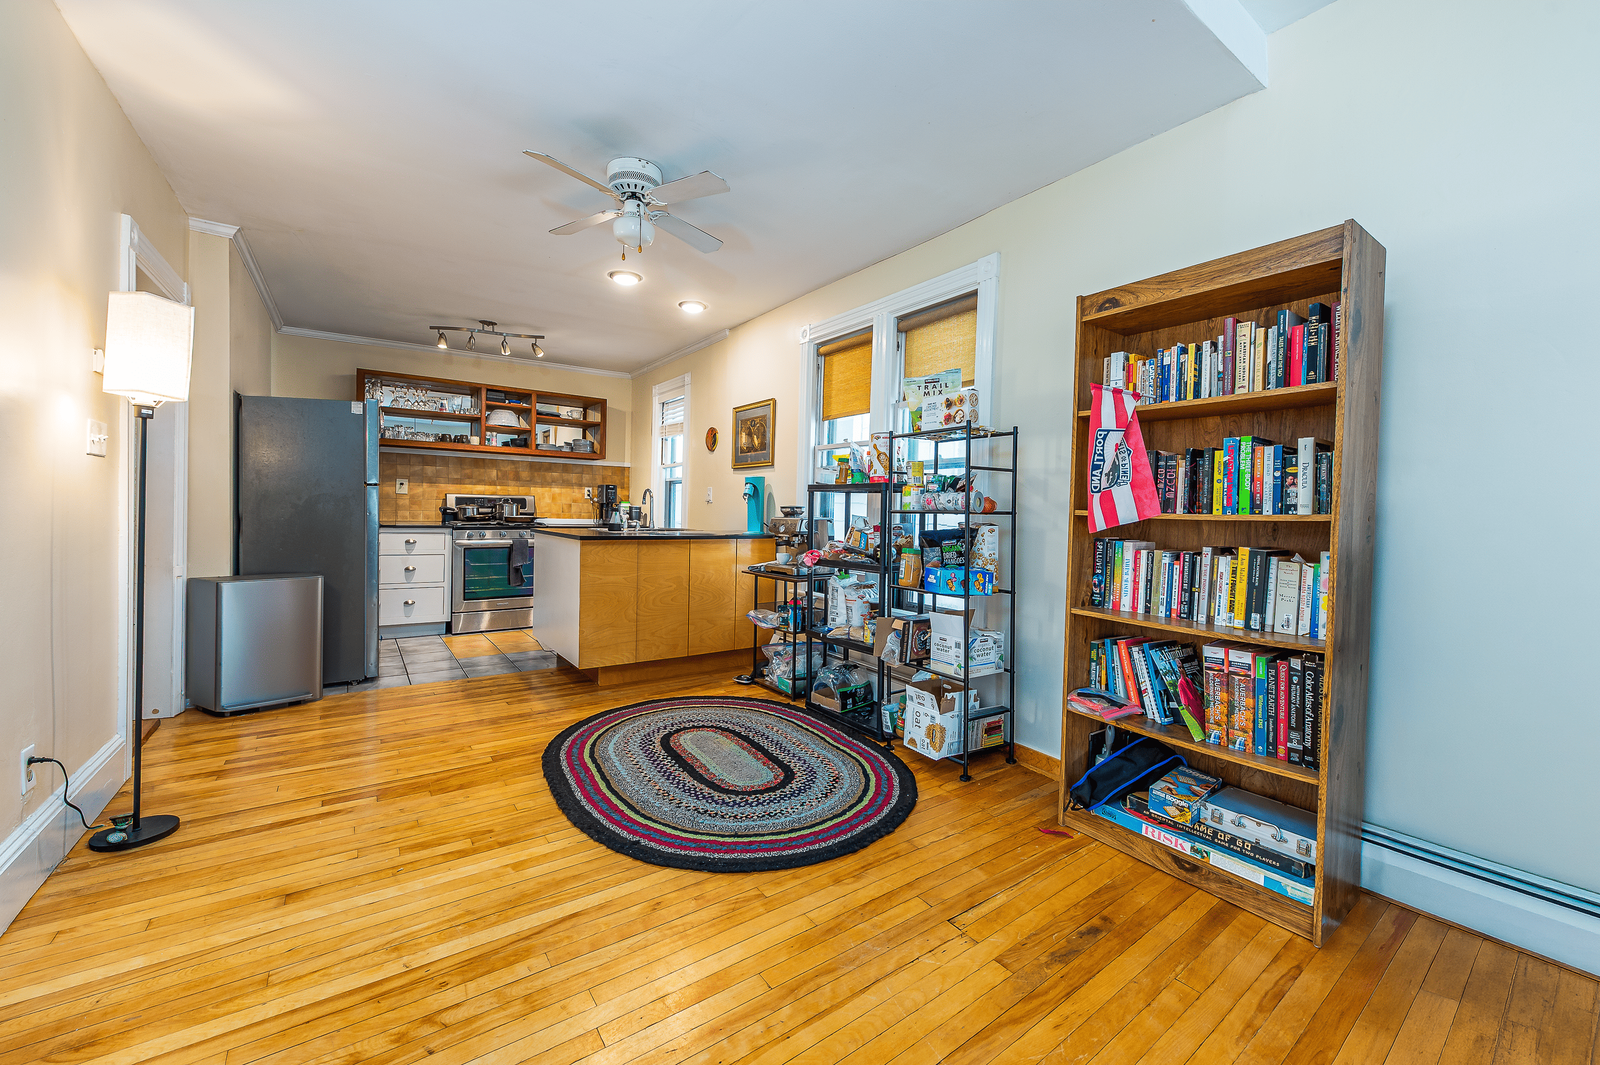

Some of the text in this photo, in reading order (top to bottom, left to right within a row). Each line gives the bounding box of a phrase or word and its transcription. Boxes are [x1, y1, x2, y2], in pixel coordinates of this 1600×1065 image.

[917, 382, 949, 391] TRAIL
[1301, 462, 1309, 489] DRACULA
[934, 642, 952, 650] coconut
[974, 646, 994, 654] coconut
[1279, 664, 1287, 681] QUEST
[1305, 671, 1314, 691] Color
[1305, 692, 1313, 707] Atlas
[1305, 707, 1314, 717] of
[1303, 717, 1314, 748] Anatomy
[1144, 825, 1187, 852] RISK
[1190, 822, 1252, 850] AME OF GO
[1176, 824, 1212, 840] INTELLECTUAL
[1214, 838, 1229, 846] GAME
[1230, 844, 1240, 852] FOR
[1255, 854, 1280, 867] PLAYERS
